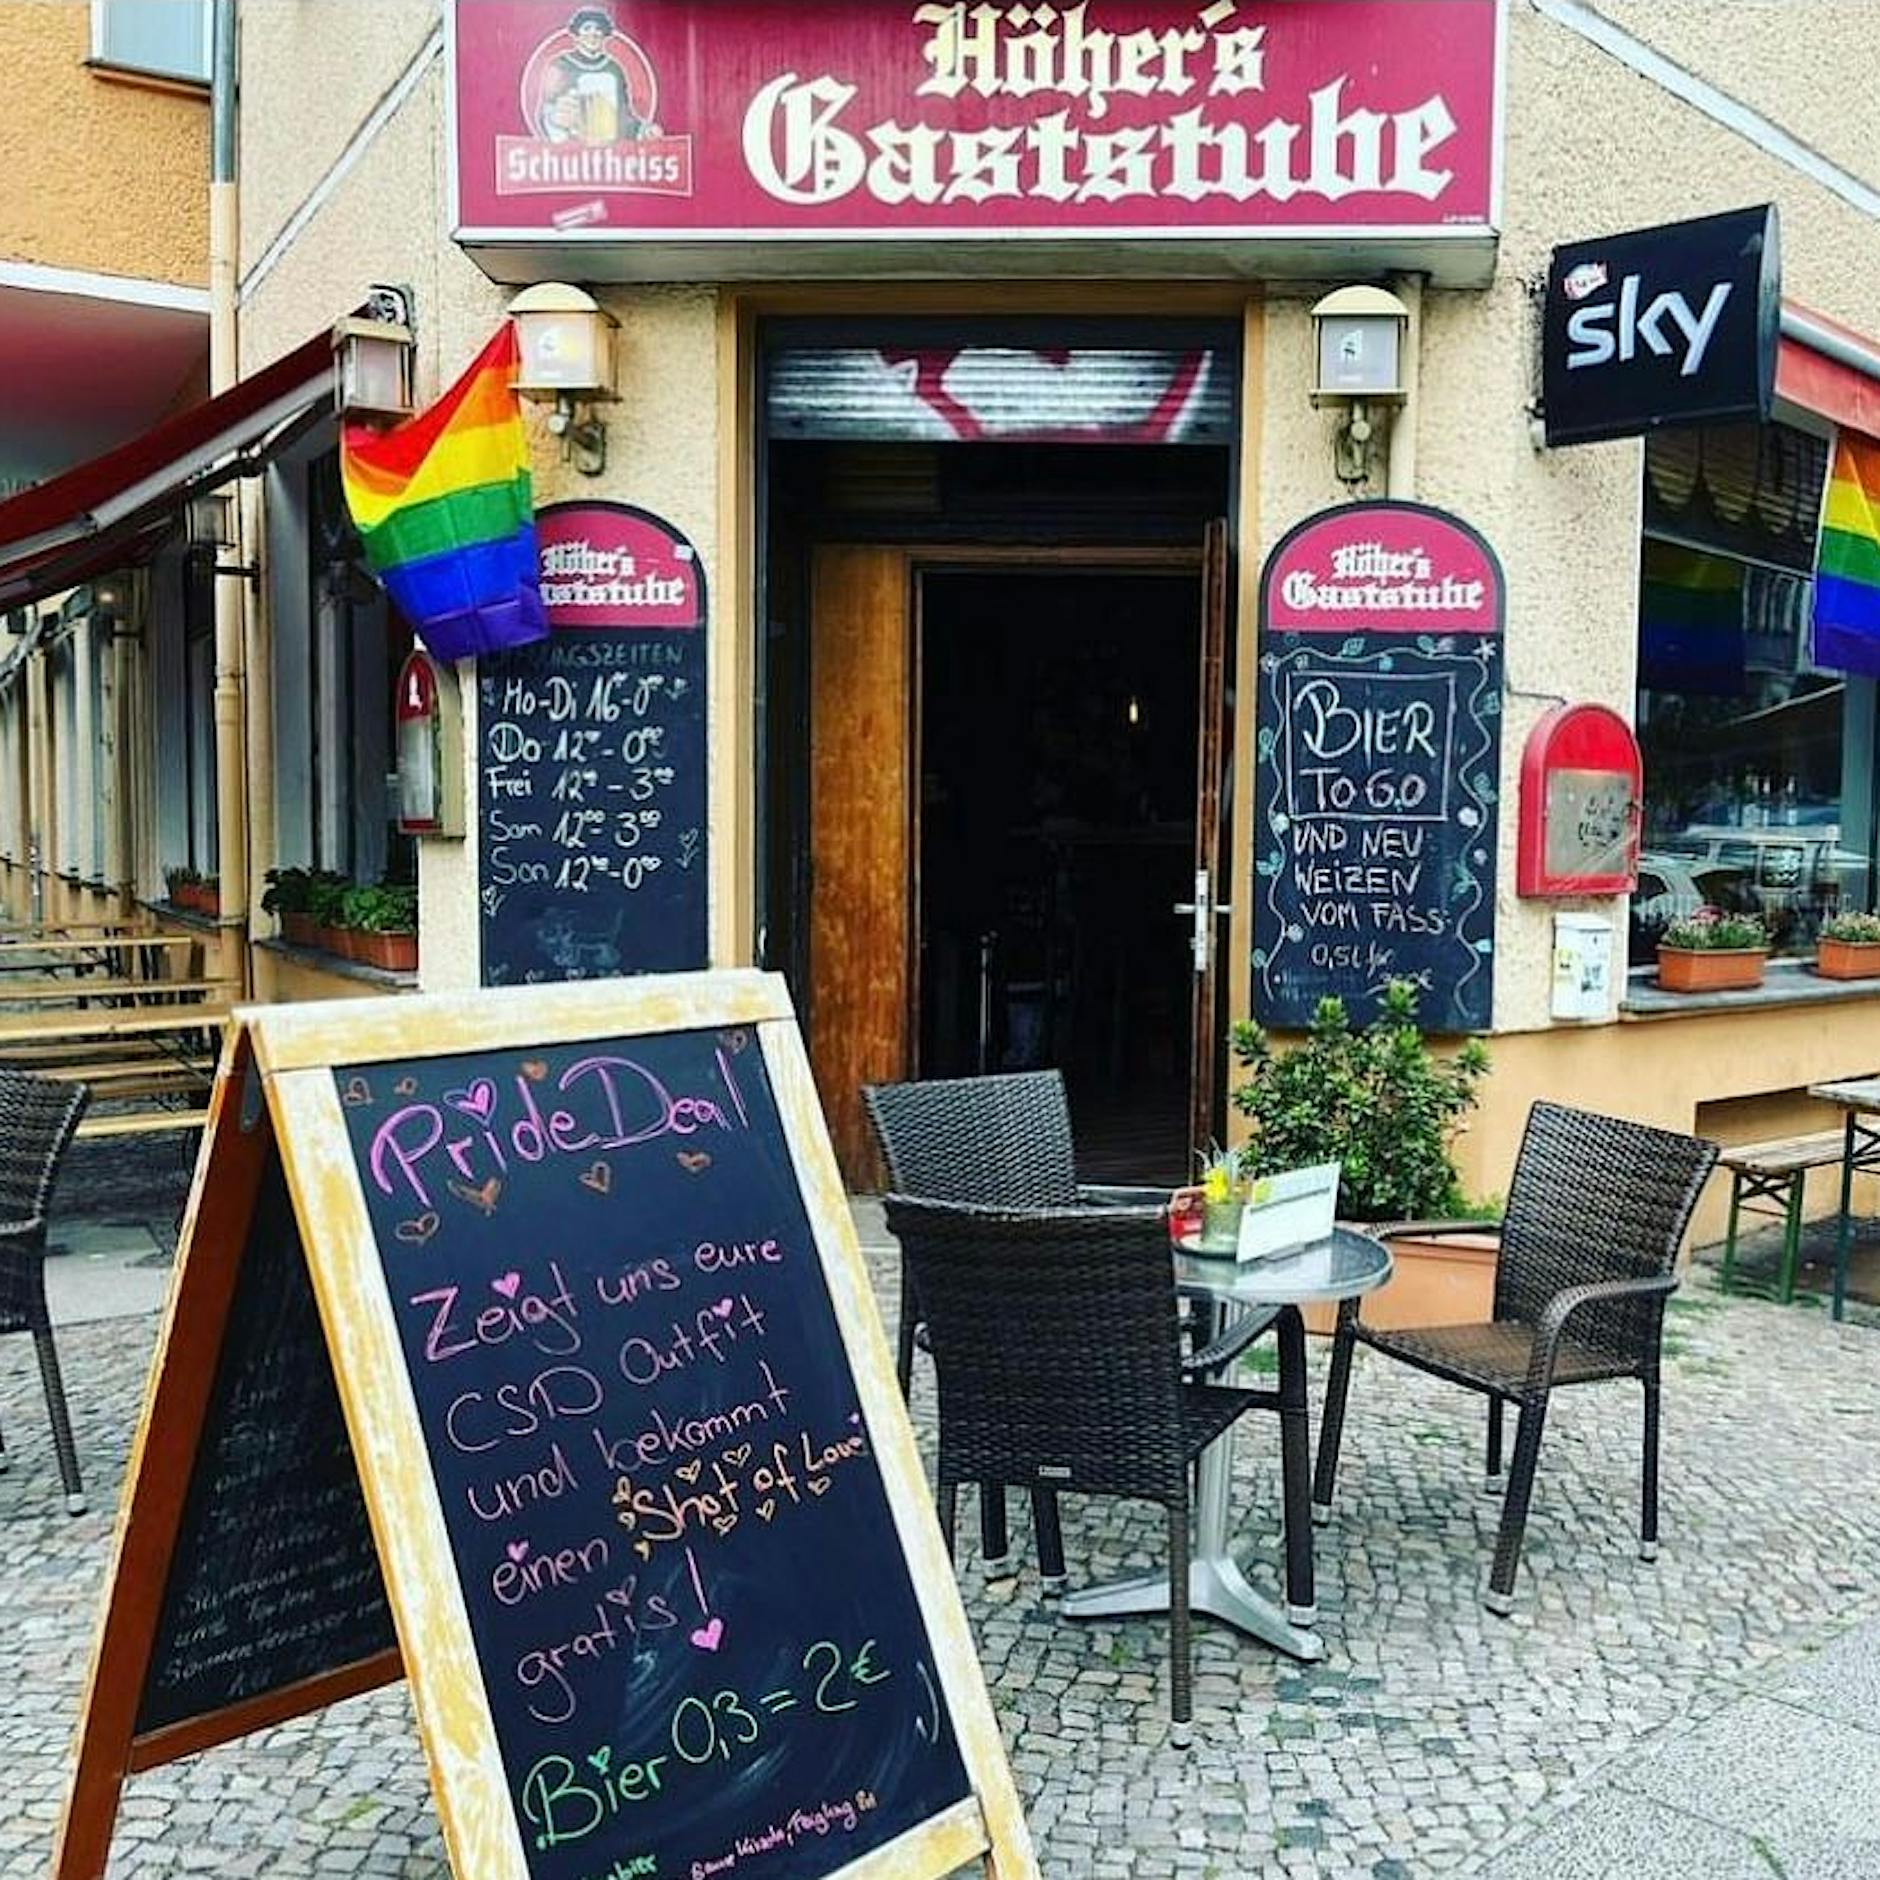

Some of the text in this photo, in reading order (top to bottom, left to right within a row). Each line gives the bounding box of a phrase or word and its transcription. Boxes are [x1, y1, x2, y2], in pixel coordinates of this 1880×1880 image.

[507, 148, 680, 183] Schultheiss
[742, 72, 1457, 204] Gaststube
[1567, 275, 1732, 377] sky
[1281, 570, 1485, 611] Gaststube
[489, 722, 541, 762] Do
[1293, 679, 1436, 769] BIER
[485, 765, 533, 799] Frei
[1299, 767, 1357, 811] TO
[1301, 900, 1361, 931] VOM
[370, 1047, 750, 1208] Pride Deal
[411, 1237, 783, 1362] Zeigt uns eure
[446, 1293, 766, 1453] CSD Outfit
[467, 1443, 579, 1521] und
[594, 1360, 791, 1471] bekommt
[492, 1537, 609, 1604] einen
[753, 1443, 800, 1503] of
[522, 1745, 667, 1850] Bier
[671, 1690, 759, 1763] 0,3
